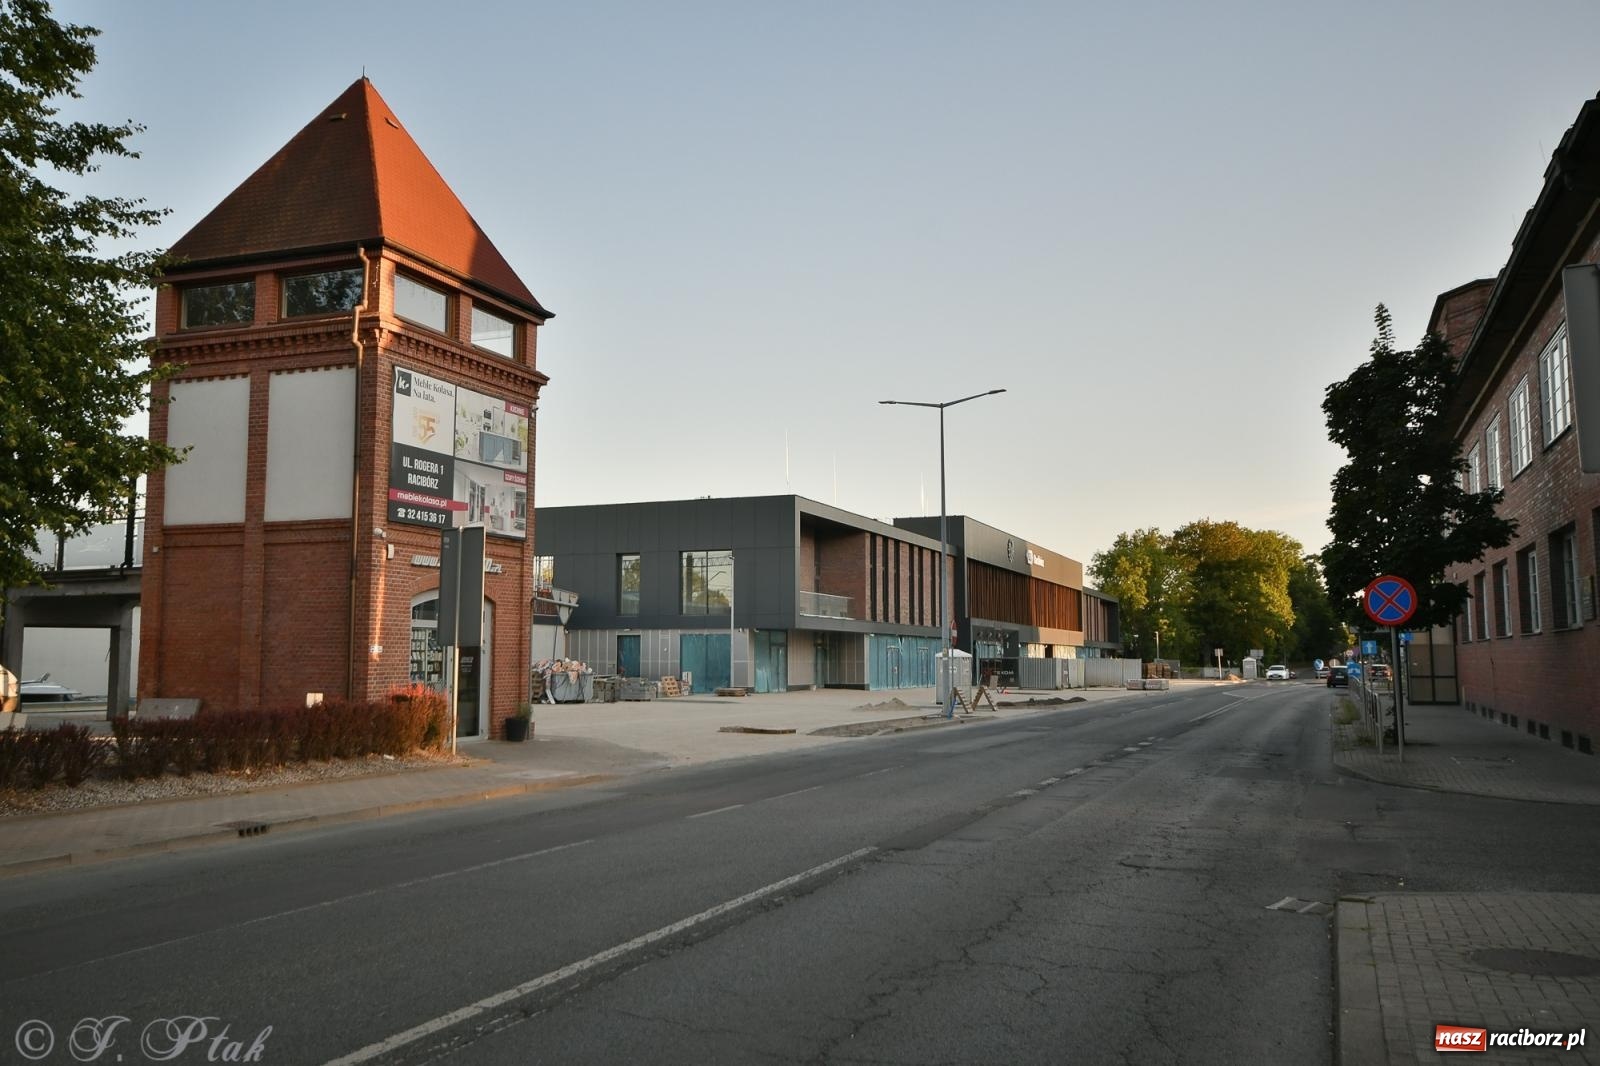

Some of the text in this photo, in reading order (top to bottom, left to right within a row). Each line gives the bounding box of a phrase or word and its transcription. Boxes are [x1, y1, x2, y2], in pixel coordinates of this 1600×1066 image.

[414, 376, 432, 390] Meble
[414, 388, 421, 398] Na
[402, 455, 444, 475] UL. ROGERA 1
[407, 472, 439, 489] RACIBÓRZ
[397, 491, 448, 508] meblekolasa.pl
[407, 508, 446, 524] 32 415 36 17
